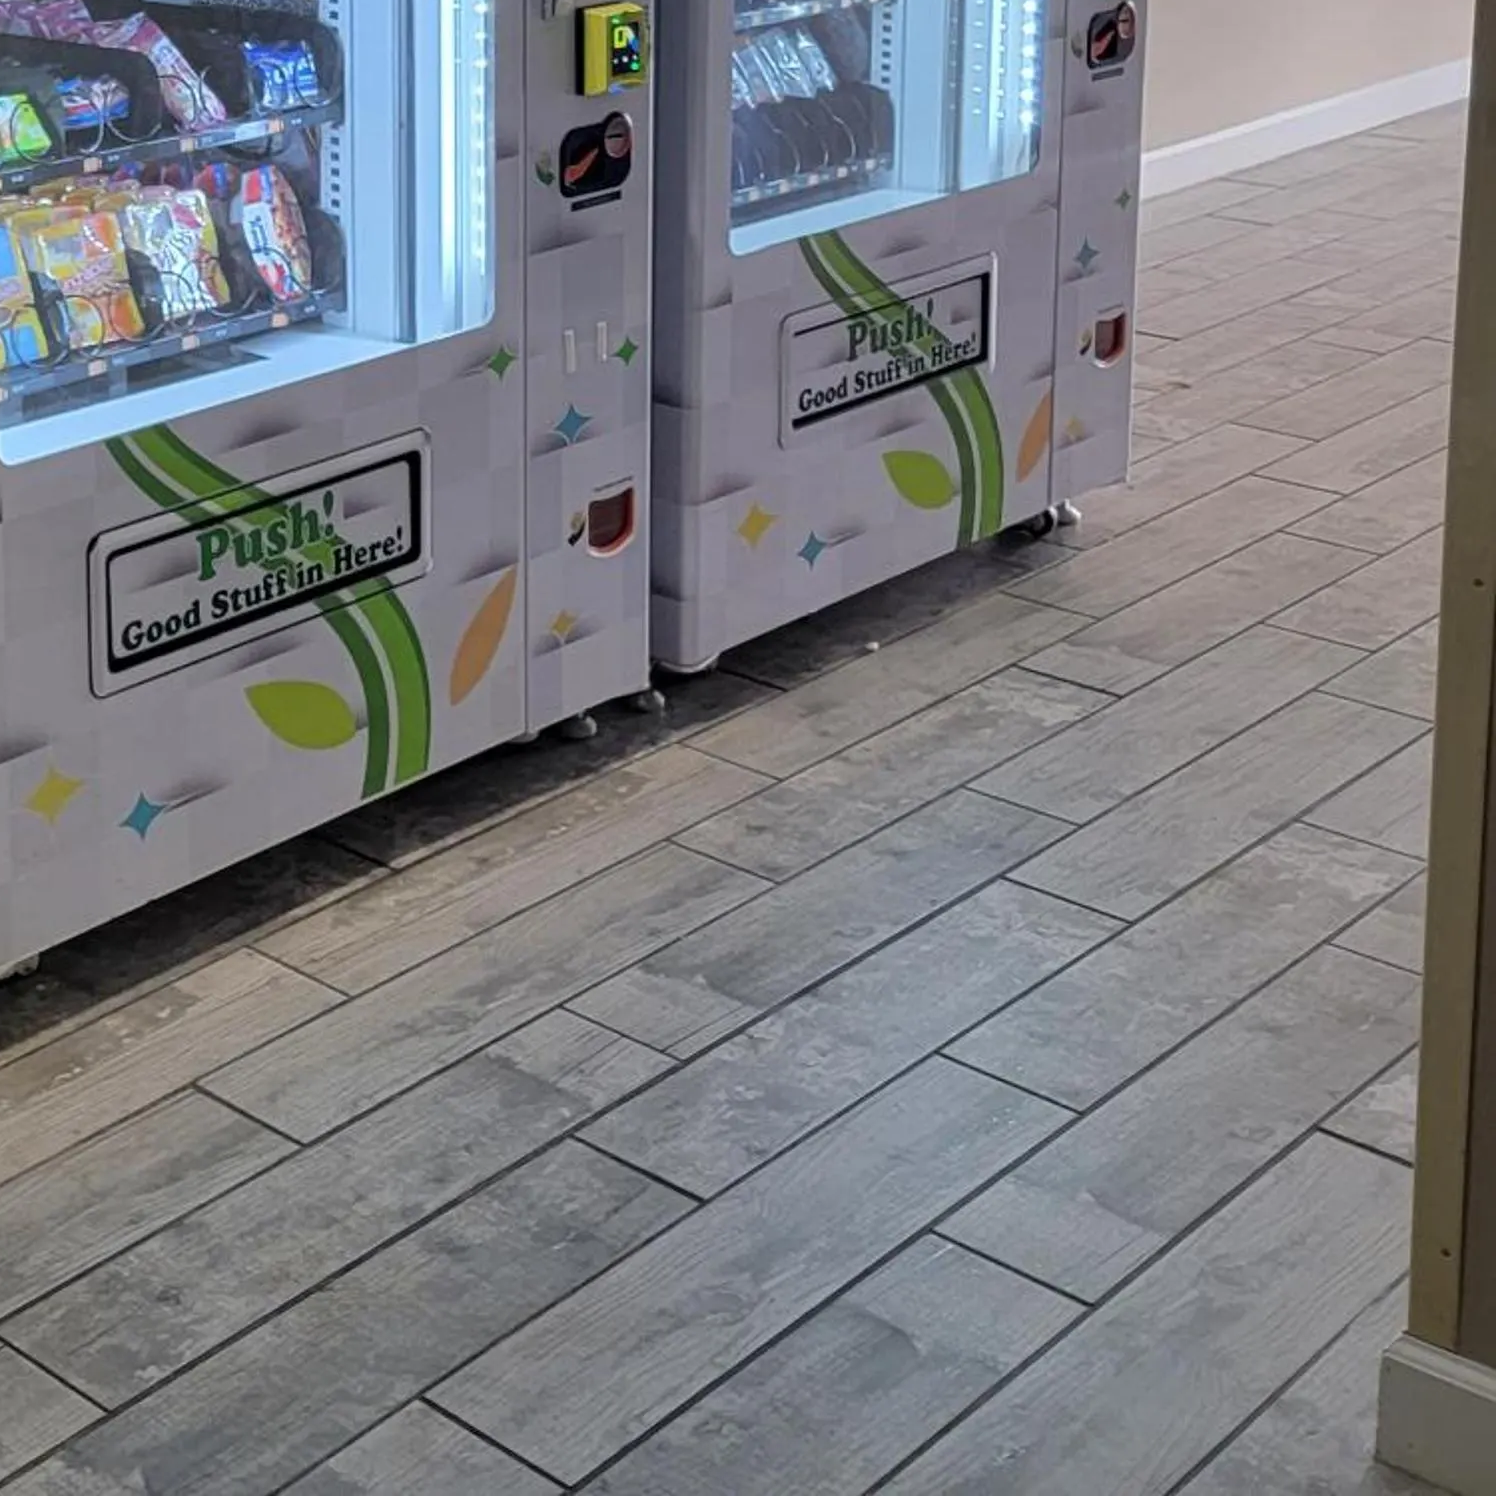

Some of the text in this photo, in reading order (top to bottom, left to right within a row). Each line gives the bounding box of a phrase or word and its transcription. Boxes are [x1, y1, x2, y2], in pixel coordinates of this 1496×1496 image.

[798, 331, 977, 412] Good Stuff in Here!
[847, 297, 934, 362] Push!
[194, 489, 335, 582] Push!
[121, 525, 404, 651] Good Stuff in Here!
